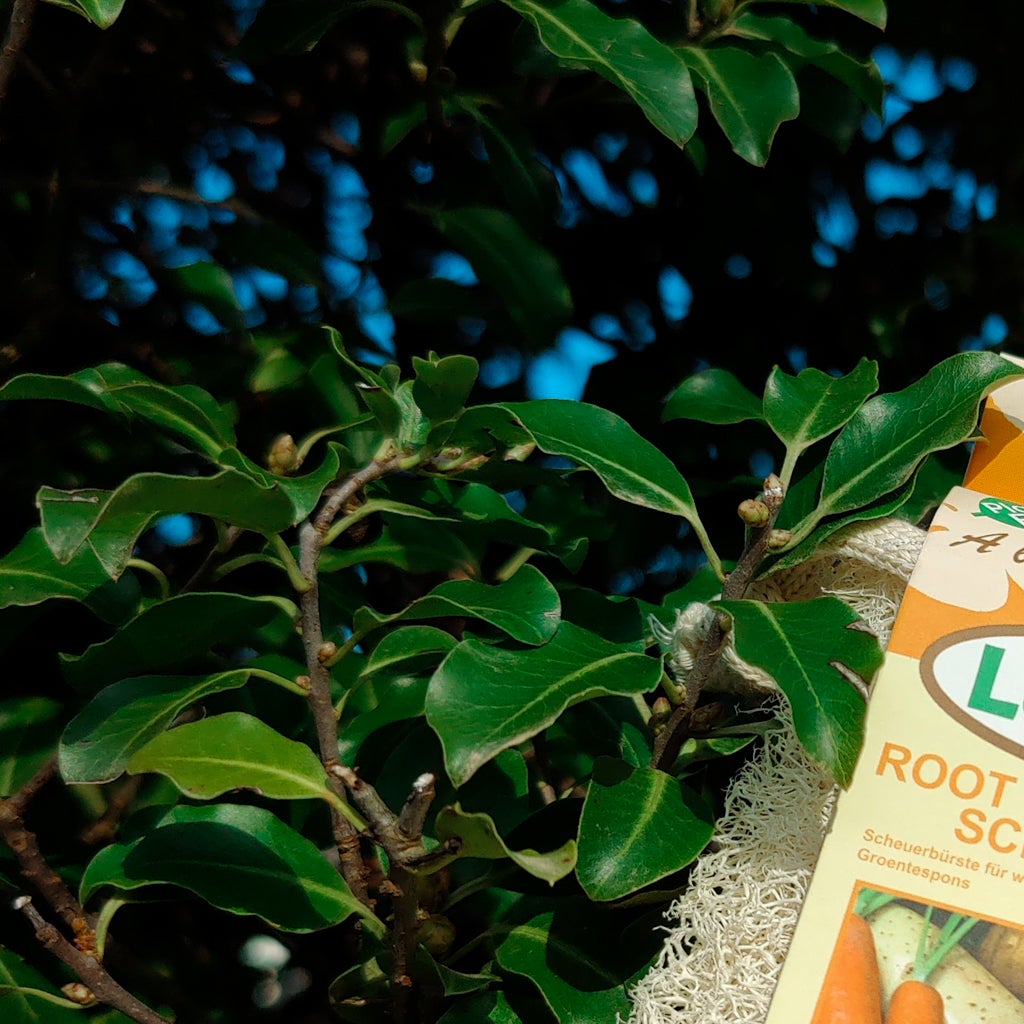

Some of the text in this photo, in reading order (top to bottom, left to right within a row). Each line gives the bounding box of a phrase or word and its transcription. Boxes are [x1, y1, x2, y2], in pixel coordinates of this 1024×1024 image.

[950, 533, 1009, 554] A
[875, 742, 1018, 808] ROOT
[856, 847, 971, 890] Groentespons
[862, 828, 981, 872] Scheuerbürste
[985, 861, 1009, 879] für
